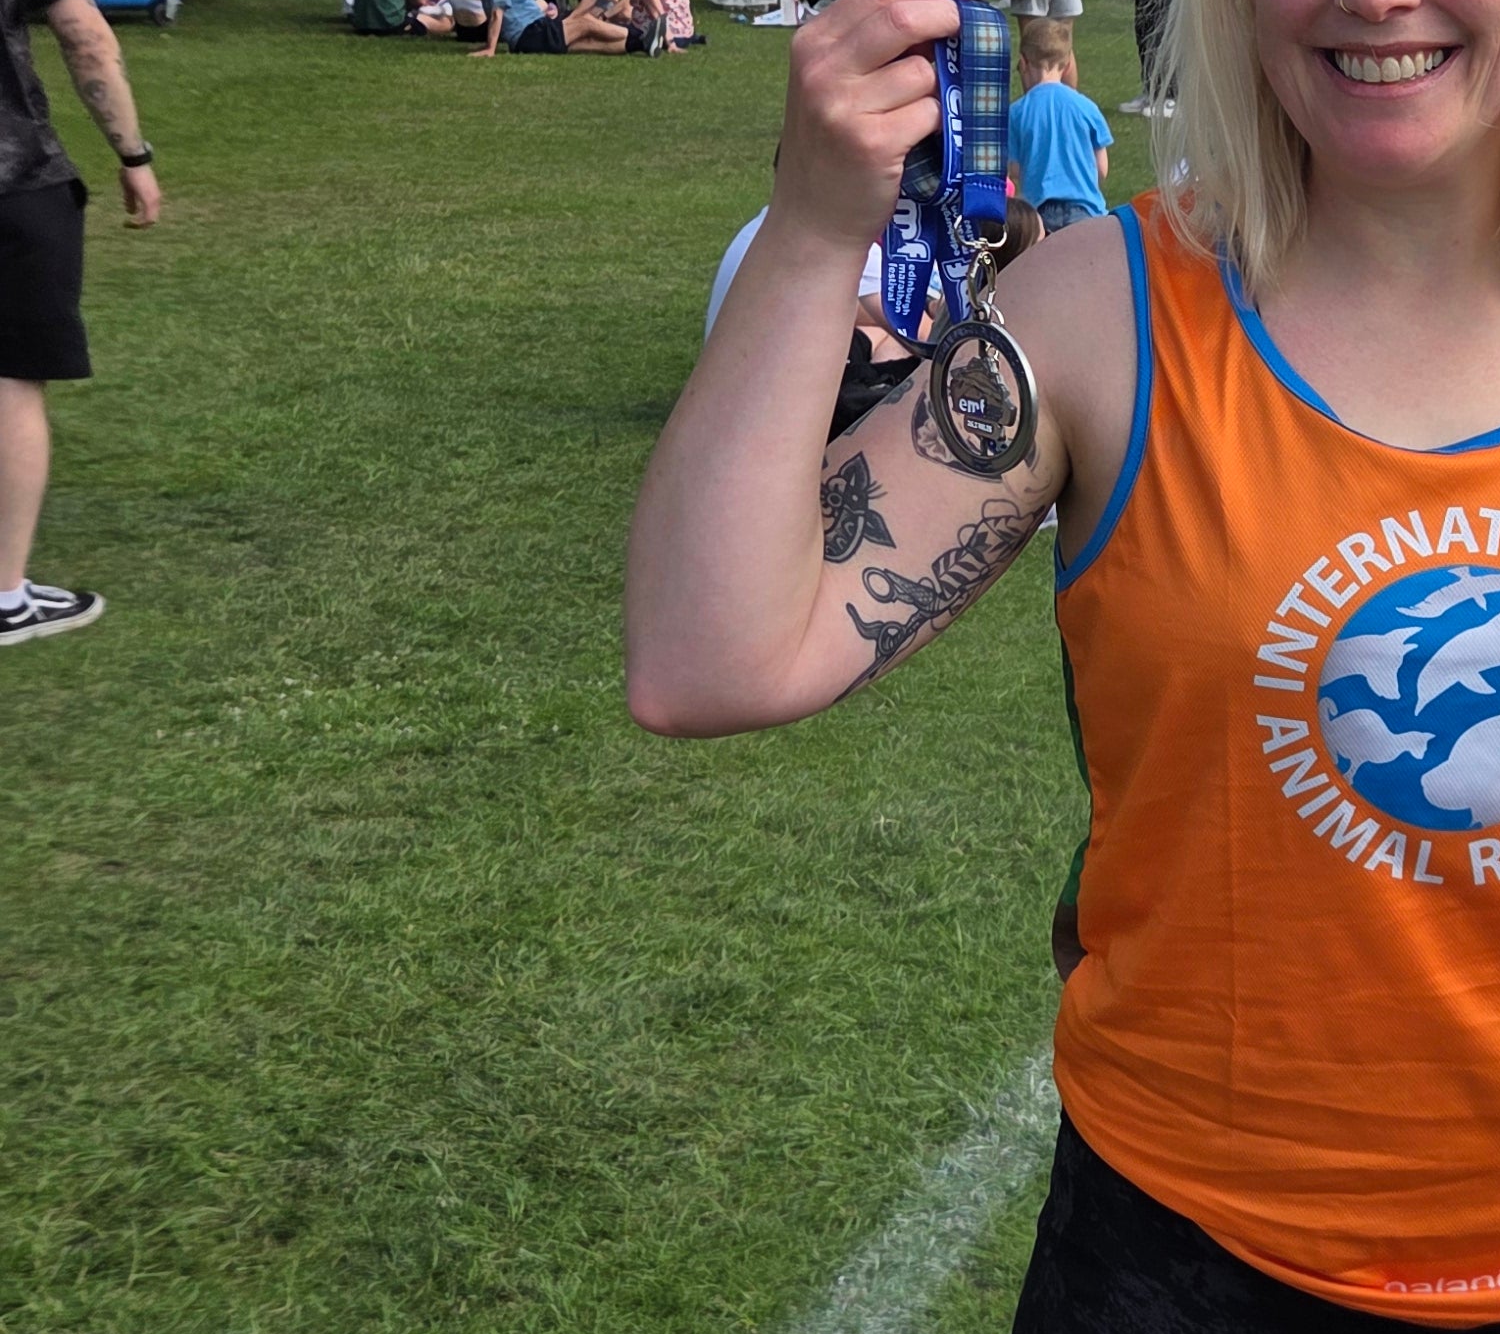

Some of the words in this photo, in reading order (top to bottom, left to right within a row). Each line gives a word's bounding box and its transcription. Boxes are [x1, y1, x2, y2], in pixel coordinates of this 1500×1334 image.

[946, 38, 959, 74] 026
[893, 199, 927, 259] mf
[887, 263, 898, 302] festival
[895, 263, 906, 313] marathon
[902, 264, 917, 316] edinburgh
[959, 398, 985, 414] emf
[1256, 713, 1445, 885] ANIMAL
